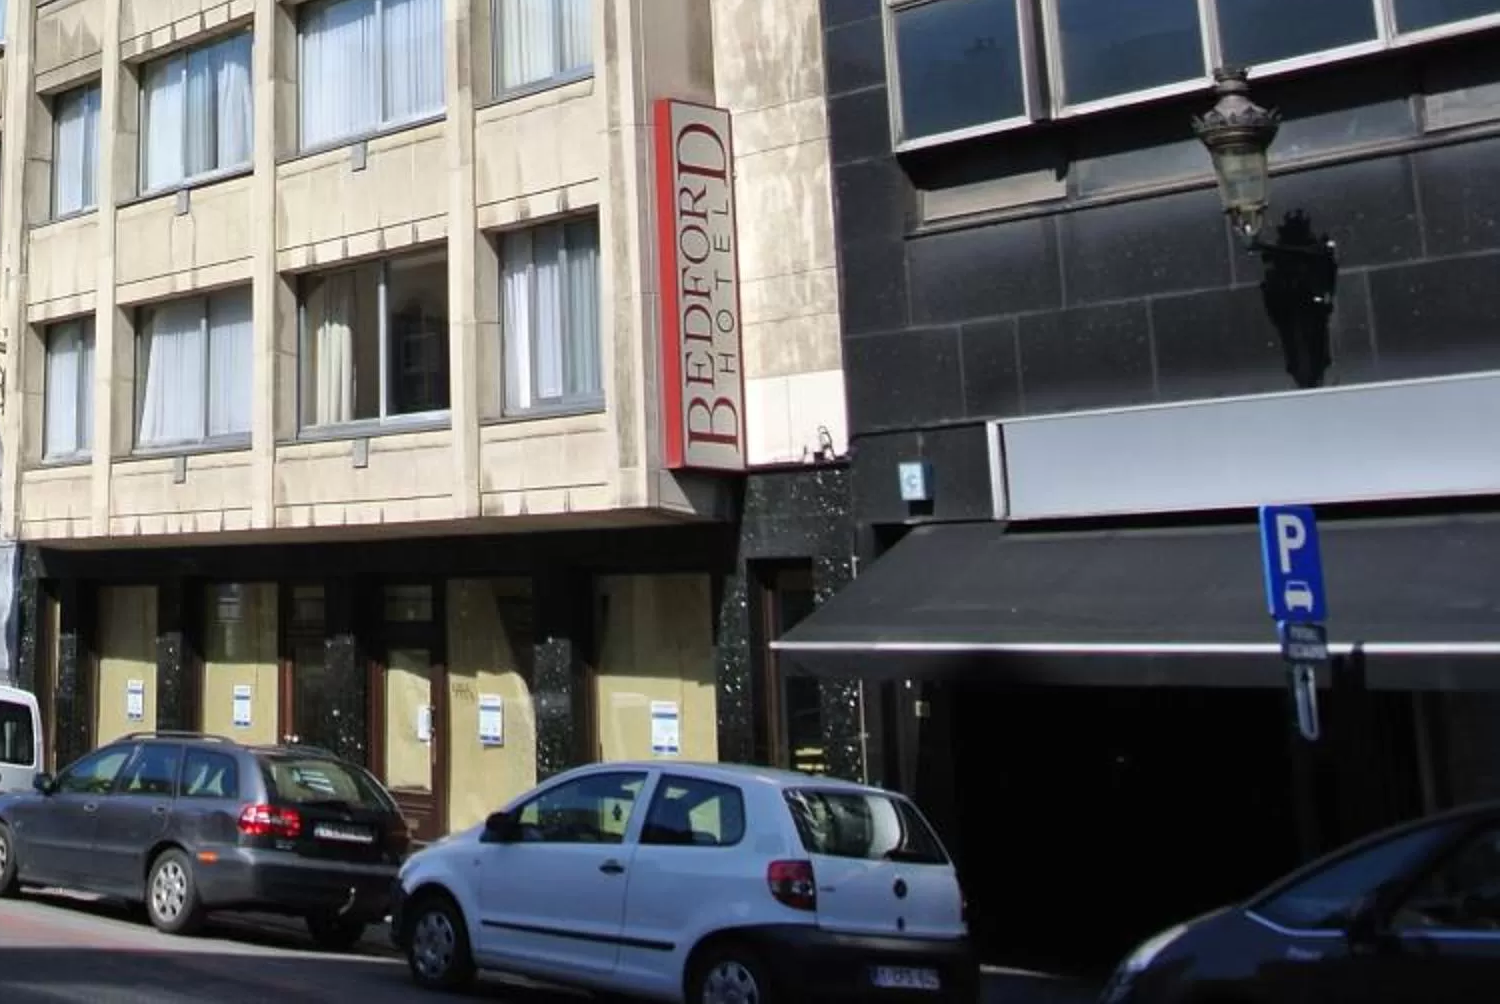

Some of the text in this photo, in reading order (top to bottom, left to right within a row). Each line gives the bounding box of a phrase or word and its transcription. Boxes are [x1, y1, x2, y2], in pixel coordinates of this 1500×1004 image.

[675, 122, 739, 453] BEDFORD
[712, 199, 736, 375] HOTEL
[1275, 513, 1307, 574] P
